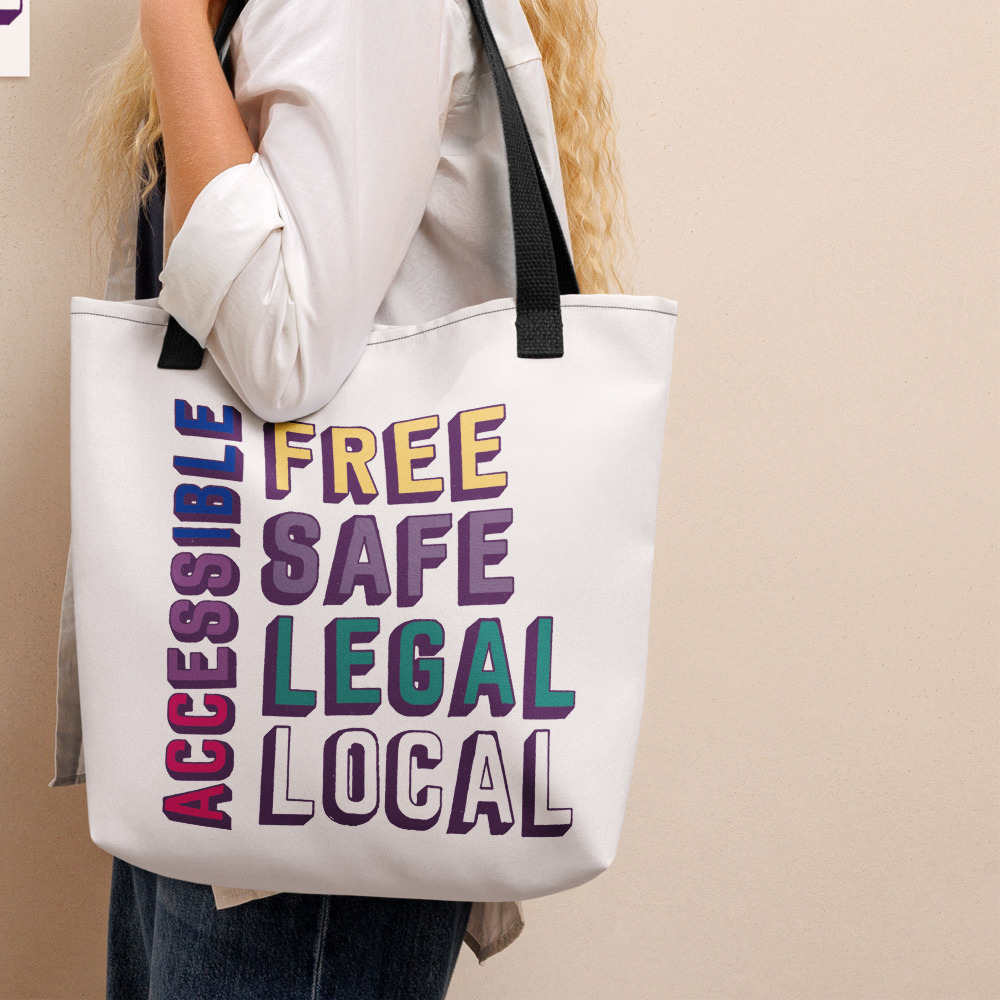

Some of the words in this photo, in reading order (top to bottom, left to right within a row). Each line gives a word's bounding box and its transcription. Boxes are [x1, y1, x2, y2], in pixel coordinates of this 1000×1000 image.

[263, 403, 508, 505] FREE
[261, 508, 514, 607] SAFE
[162, 398, 244, 830] ACCESSIBLE
[262, 615, 576, 720] LEGAL
[259, 725, 574, 838] LOCAL
